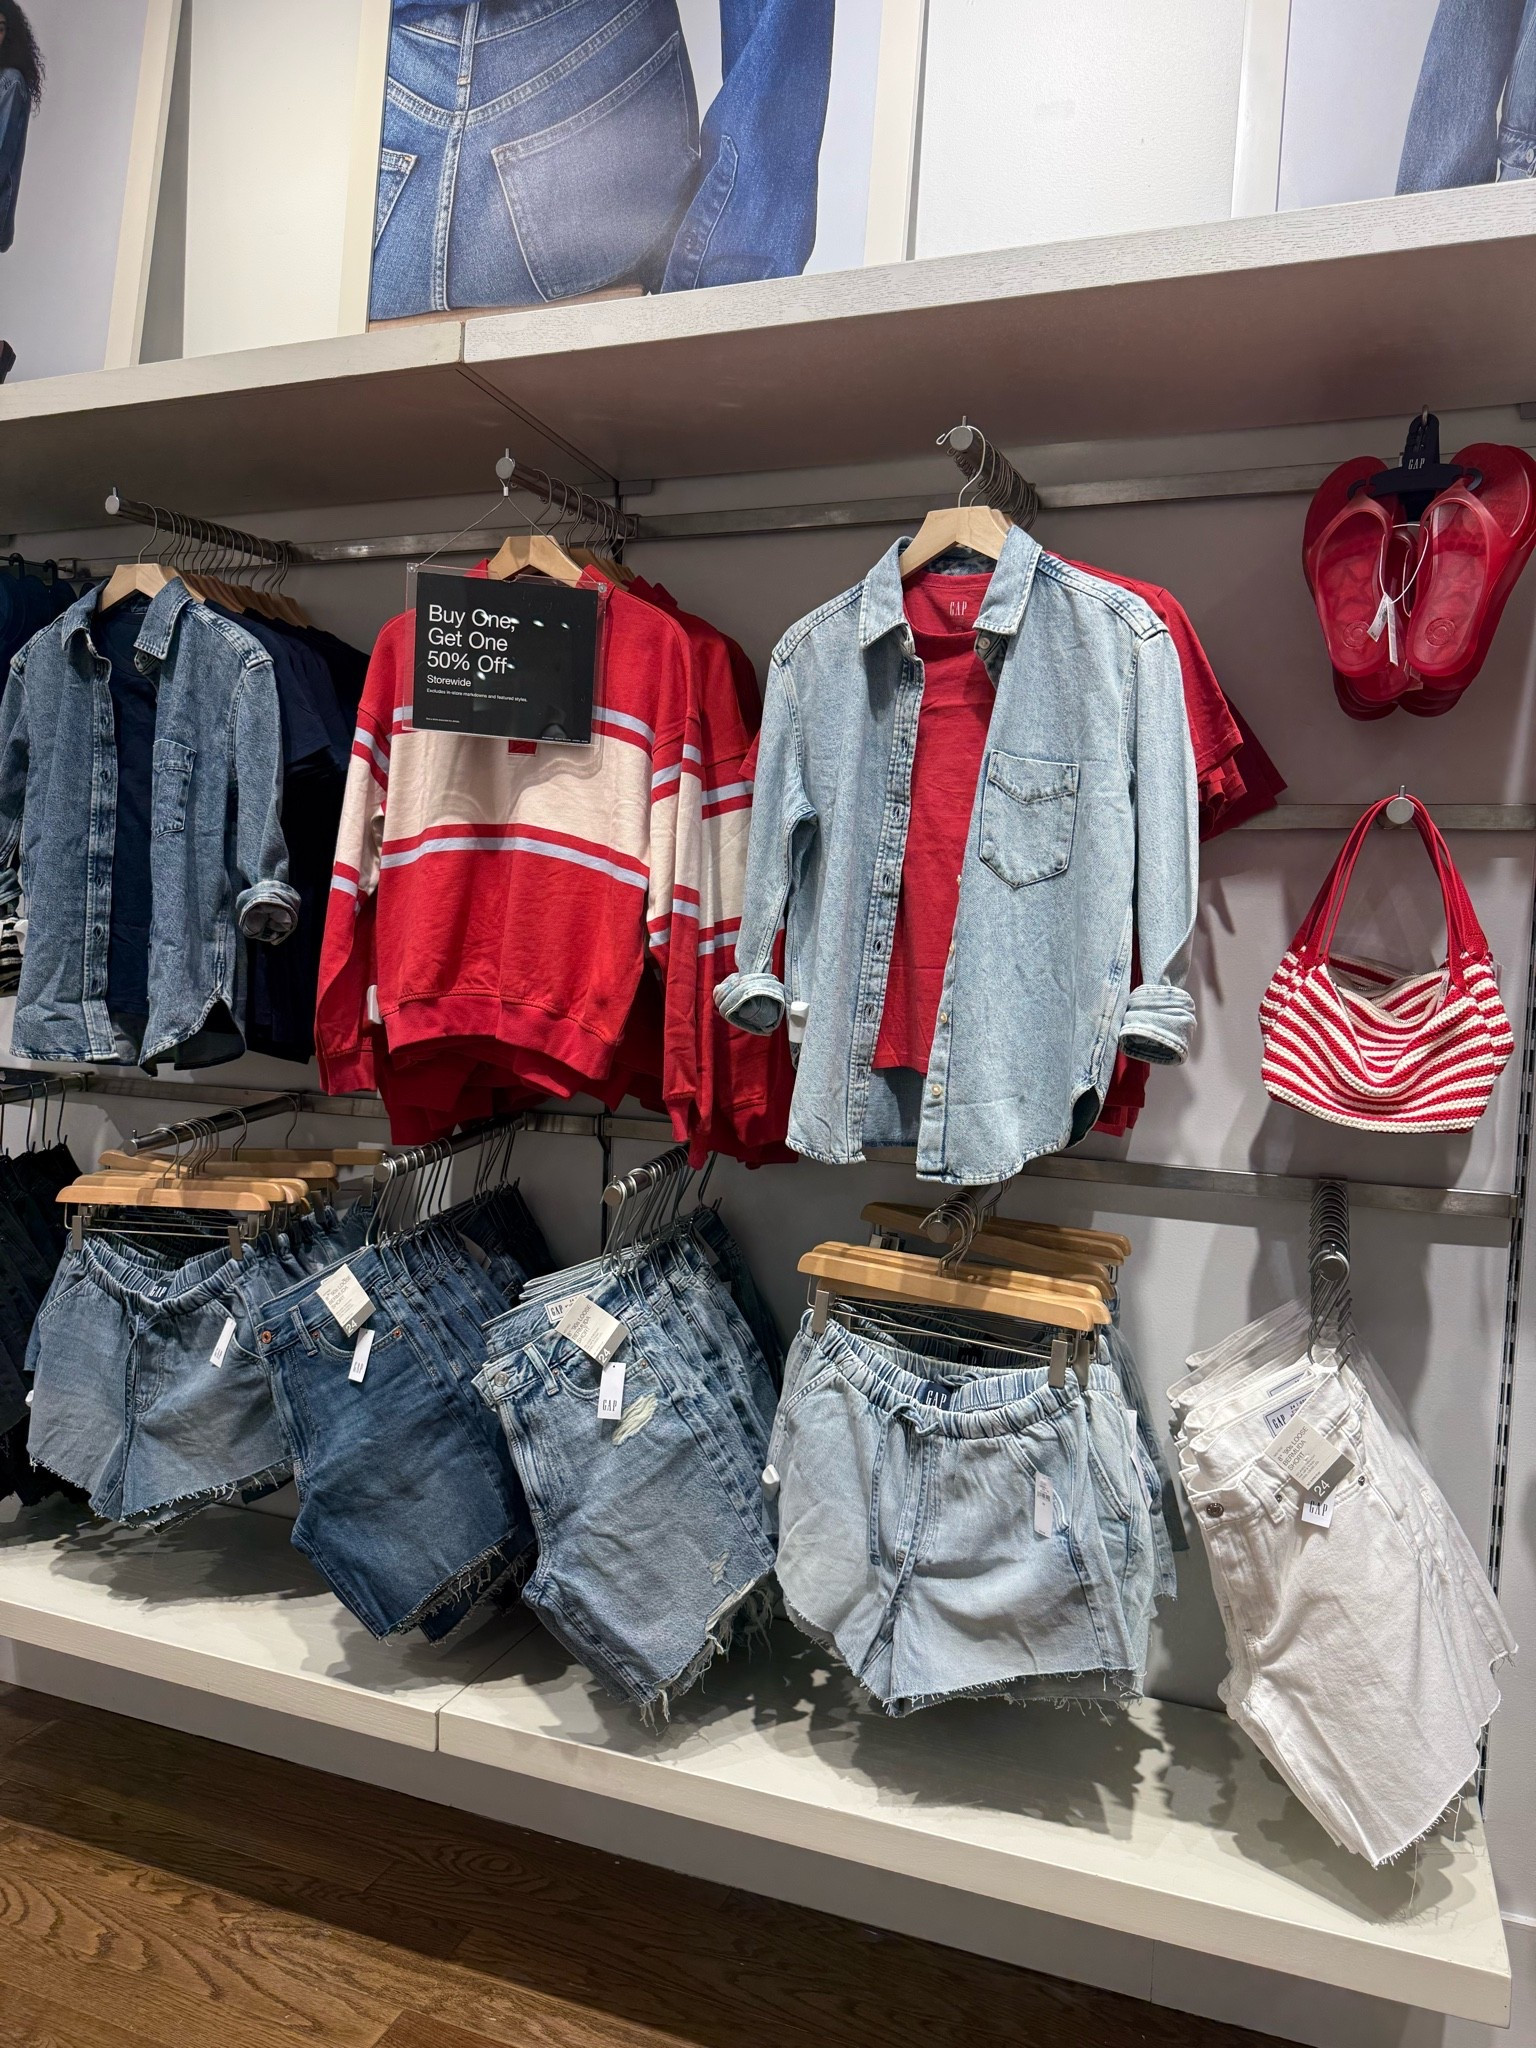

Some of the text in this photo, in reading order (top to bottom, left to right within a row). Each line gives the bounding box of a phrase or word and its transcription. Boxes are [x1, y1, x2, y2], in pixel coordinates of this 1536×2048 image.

[1408, 457, 1426, 470] GAP
[949, 601, 968, 616] GAP
[428, 604, 515, 633] Buy One,
[428, 627, 508, 652] Get One
[427, 650, 508, 674] 50% Off
[426, 674, 472, 687] Storewide
[426, 687, 446, 695] Excludes
[463, 691, 488, 699] markdowns
[550, 1304, 564, 1317] GAP
[345, 1319, 358, 1333] 24
[598, 1348, 611, 1364] 24
[602, 1399, 618, 1412] GAP
[926, 1390, 948, 1409] GAP
[1271, 1414, 1287, 1430] GAP
[1291, 1426, 1309, 1446] LOOSE
[1282, 1439, 1307, 1467] BERMUDA
[1287, 1451, 1306, 1471] SHORT
[1313, 1480, 1331, 1497] 24
[1309, 1500, 1329, 1517] GAP
